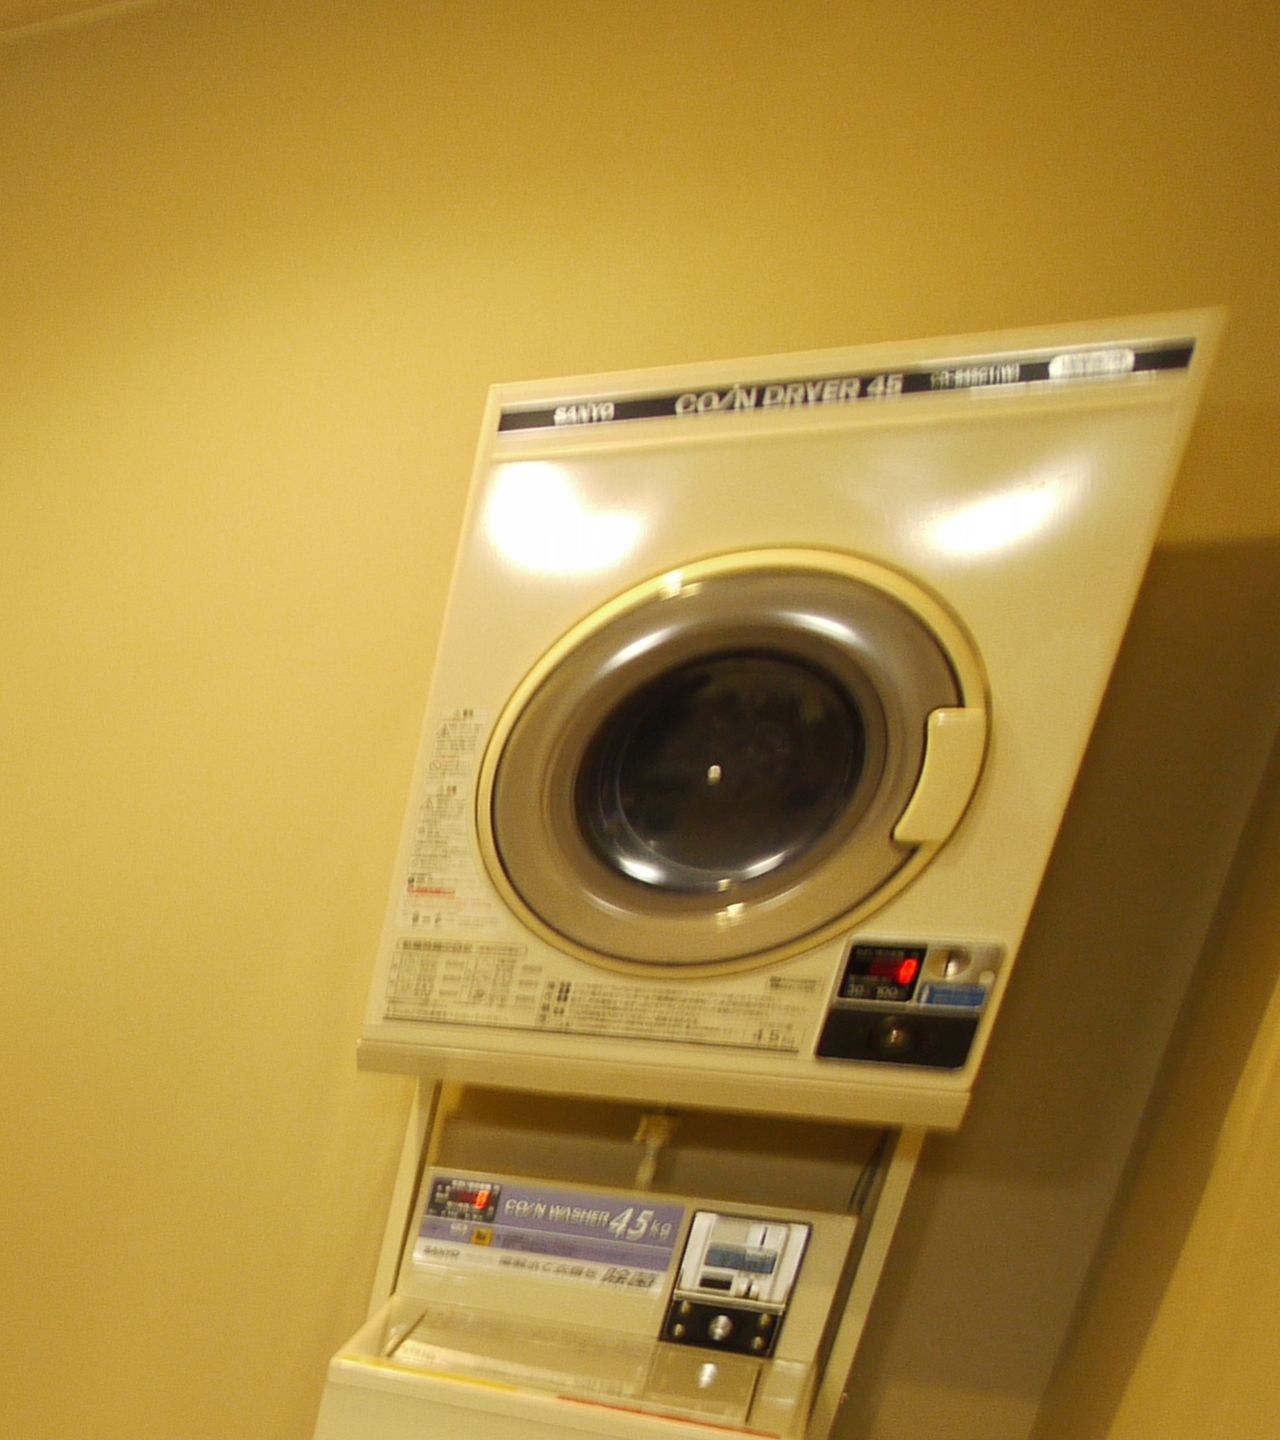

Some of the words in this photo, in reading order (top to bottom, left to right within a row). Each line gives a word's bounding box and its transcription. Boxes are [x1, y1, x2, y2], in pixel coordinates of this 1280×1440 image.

[762, 376, 861, 409] DRYER
[553, 401, 616, 425] SANYO
[546, 1204, 610, 1230] WASHER
